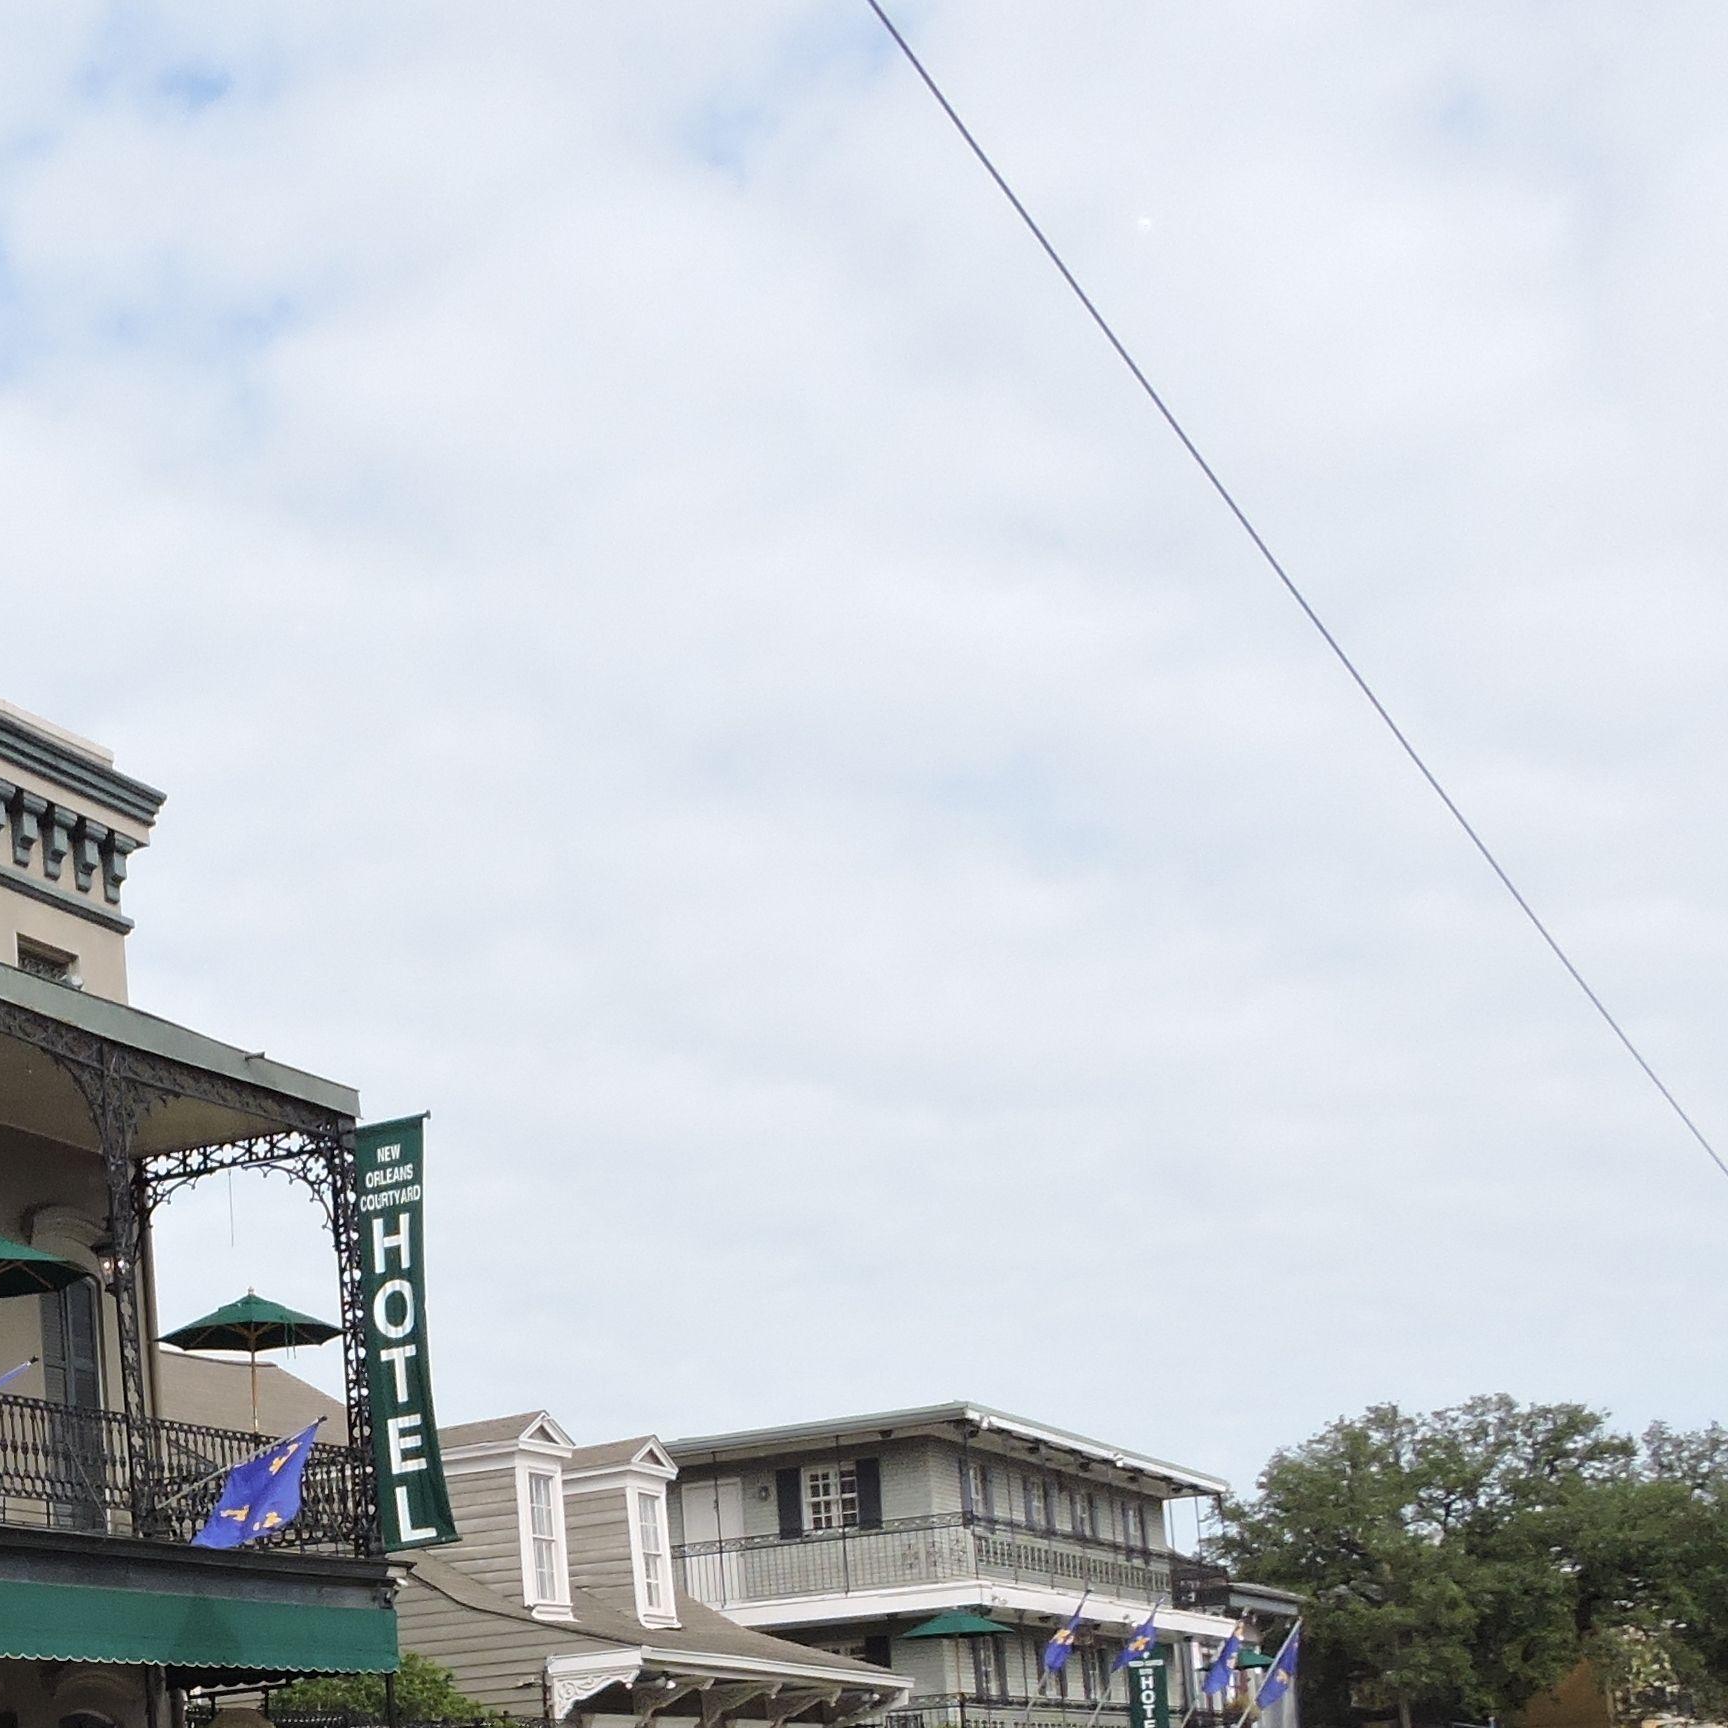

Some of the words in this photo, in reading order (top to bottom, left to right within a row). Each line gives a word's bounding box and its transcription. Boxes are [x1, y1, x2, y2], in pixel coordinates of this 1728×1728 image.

[376, 1143, 401, 1163] NEW
[365, 1162, 414, 1188] ORLEANS
[360, 1184, 421, 1212] COURTYARD
[372, 1212, 437, 1543] HOTEL
